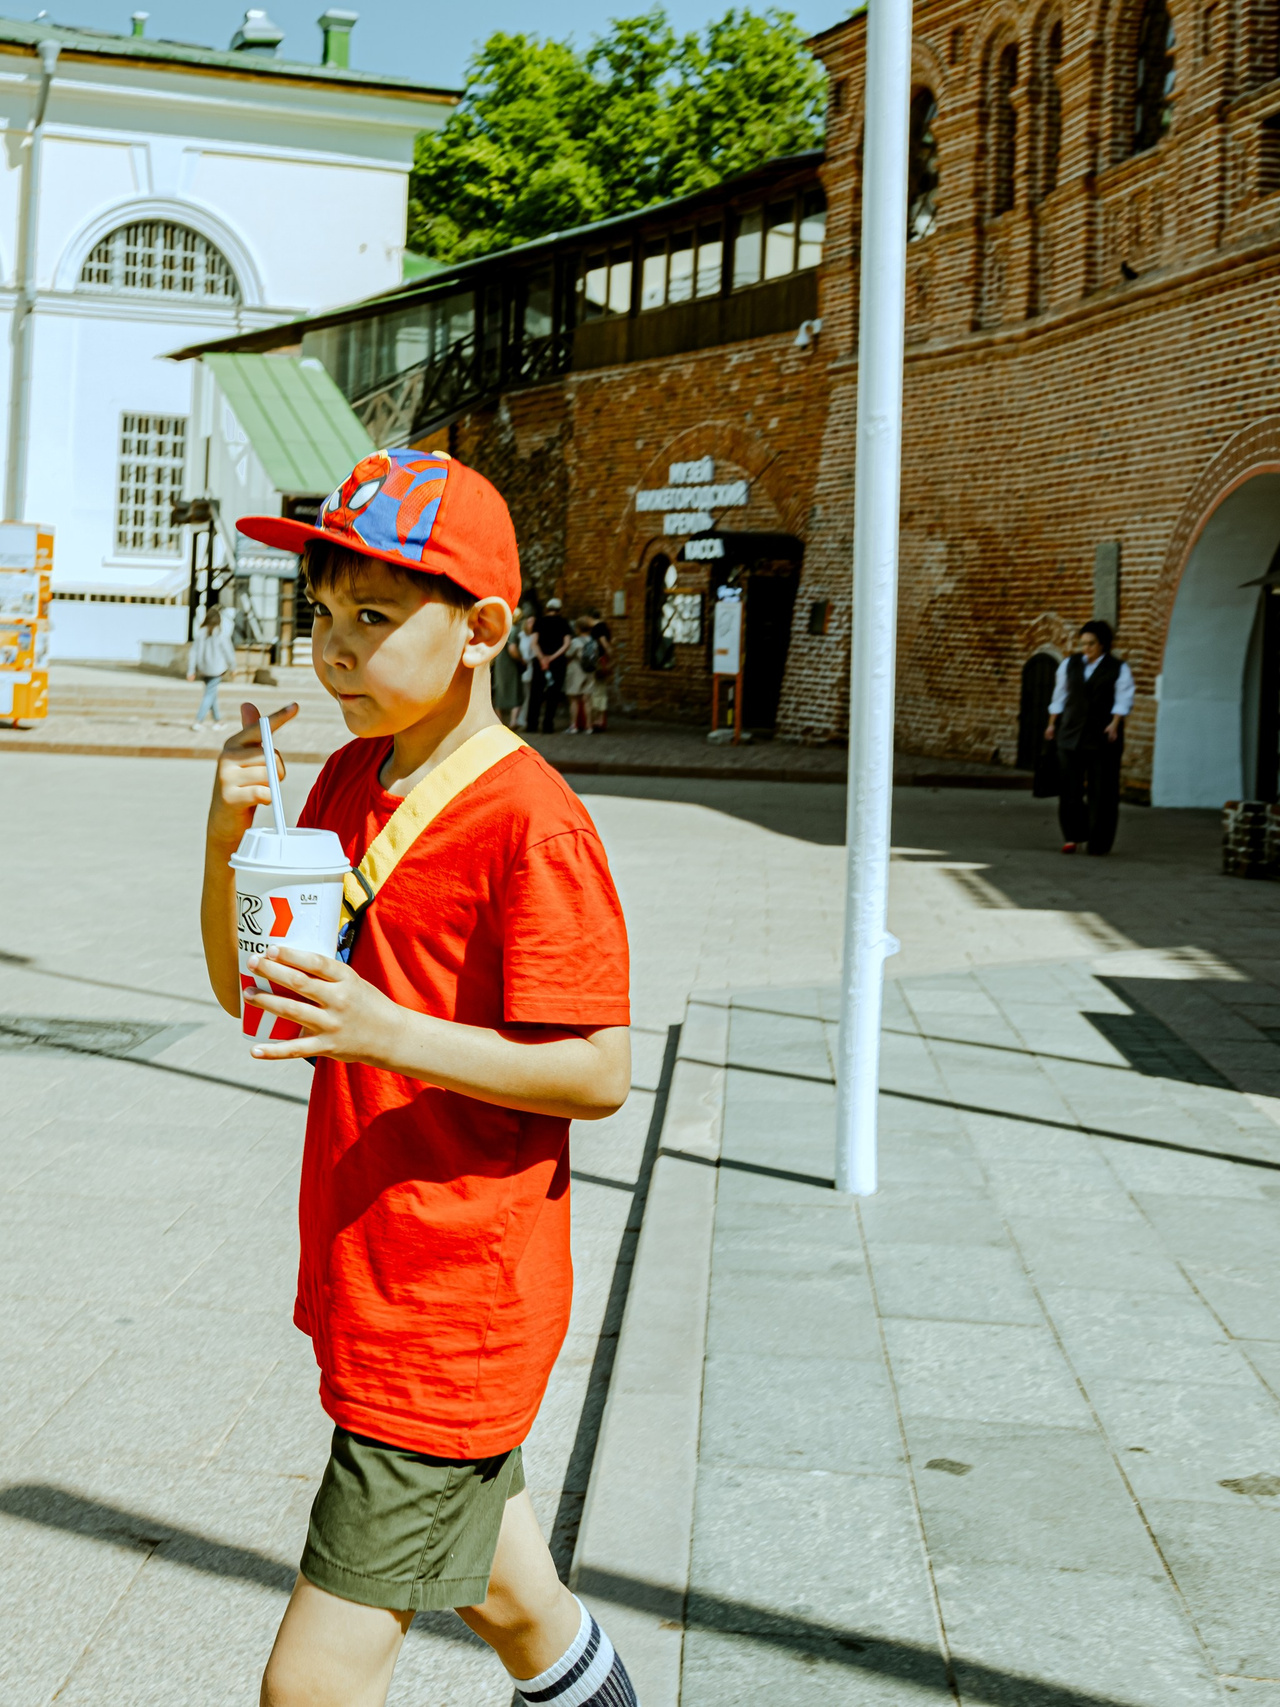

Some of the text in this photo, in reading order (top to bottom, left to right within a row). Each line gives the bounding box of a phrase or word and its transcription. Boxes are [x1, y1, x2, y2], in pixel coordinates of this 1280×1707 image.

[668, 455, 713, 485] МУЗЕЙ
[635, 479, 747, 511] НИЖЕГОРОДСКИЙ
[685, 538, 724, 560] КАССА
